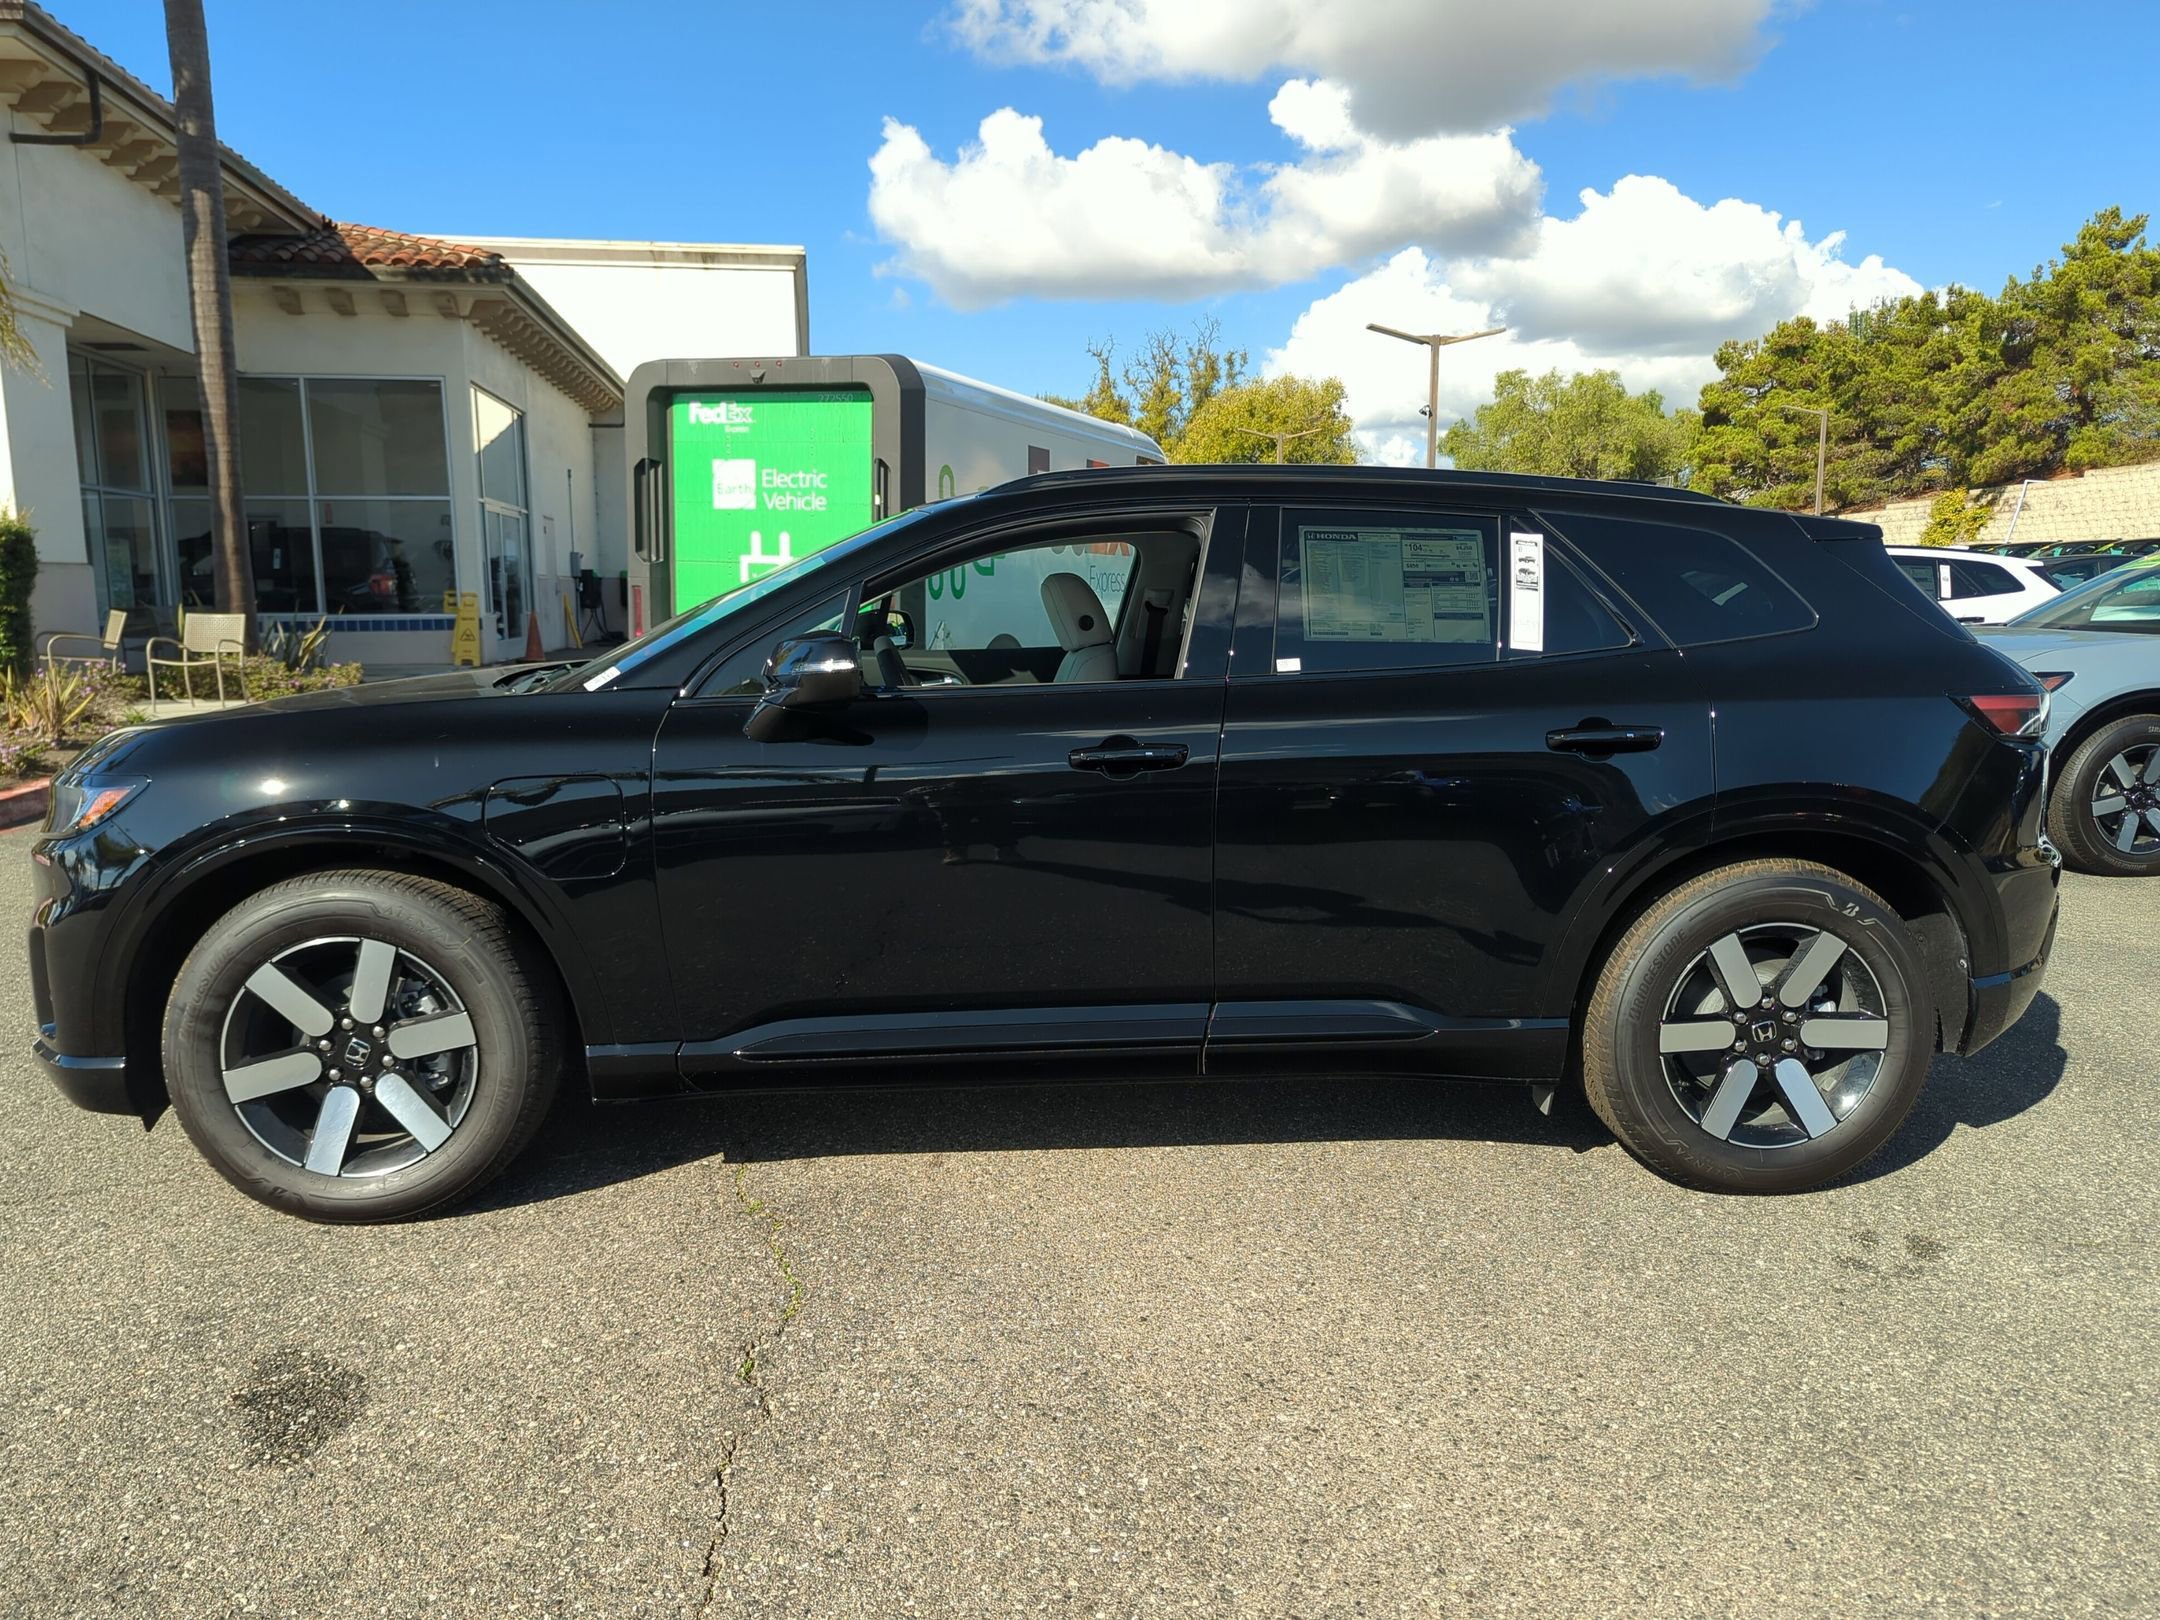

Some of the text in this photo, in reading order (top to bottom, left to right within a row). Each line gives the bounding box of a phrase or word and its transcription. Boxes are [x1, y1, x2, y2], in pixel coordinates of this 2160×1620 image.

[689, 402, 755, 424] FedEx
[761, 468, 828, 489] Electric
[716, 483, 750, 496] Earth
[763, 492, 827, 511] Vehicle
[1089, 565, 1125, 600] Express
[1628, 928, 1688, 1023] BRIDGESTONE
